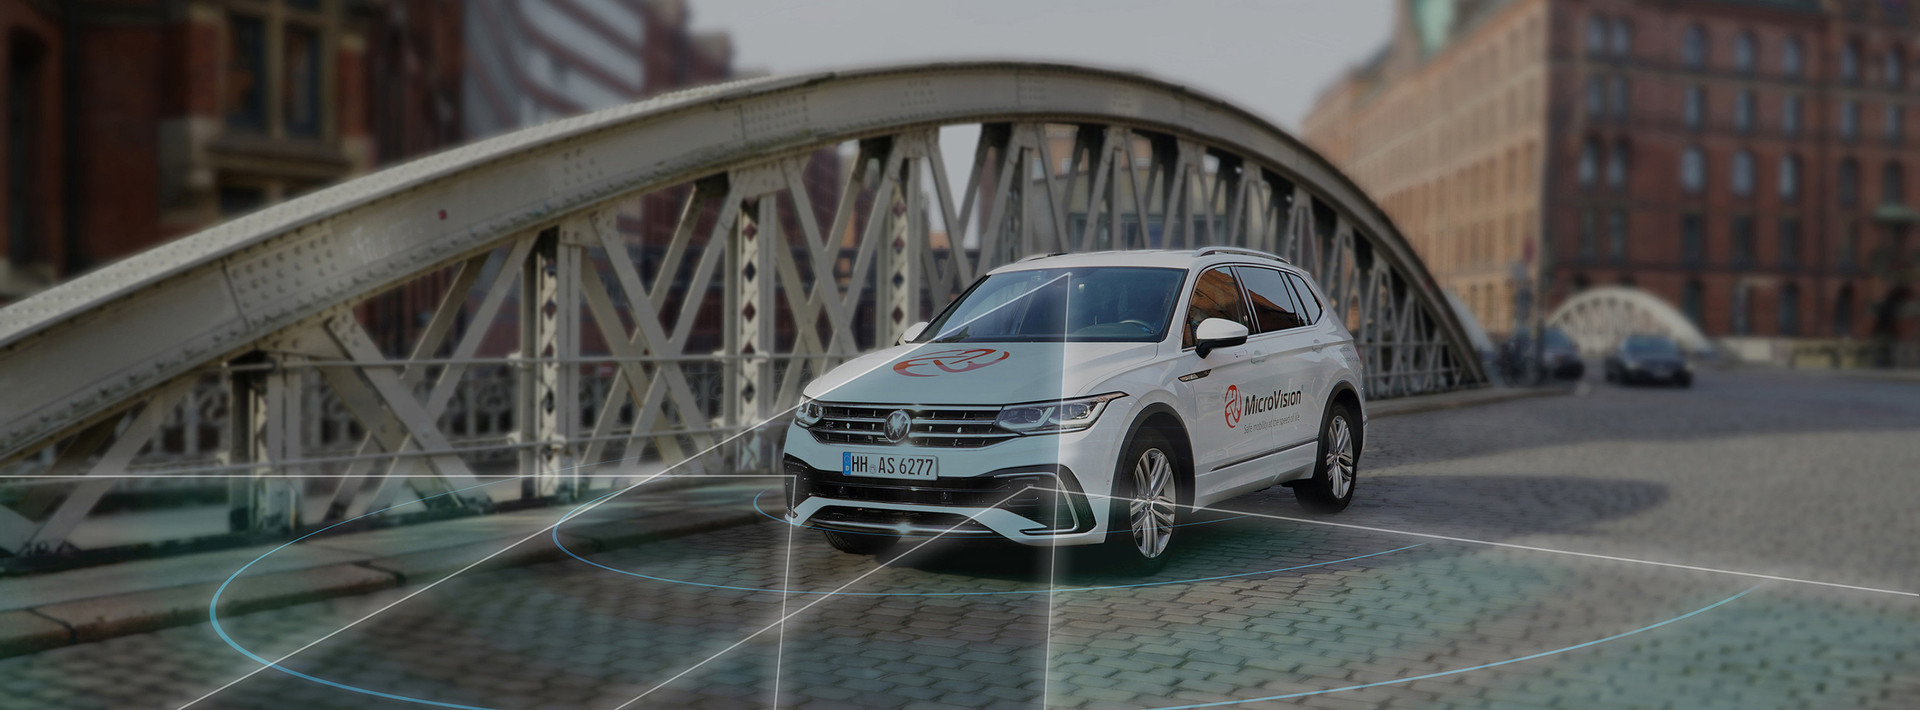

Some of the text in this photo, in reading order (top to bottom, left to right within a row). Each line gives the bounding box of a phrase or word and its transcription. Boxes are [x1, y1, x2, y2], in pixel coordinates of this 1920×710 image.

[1244, 390, 1302, 416] MicroVision
[852, 456, 933, 476] HH AS 6277
